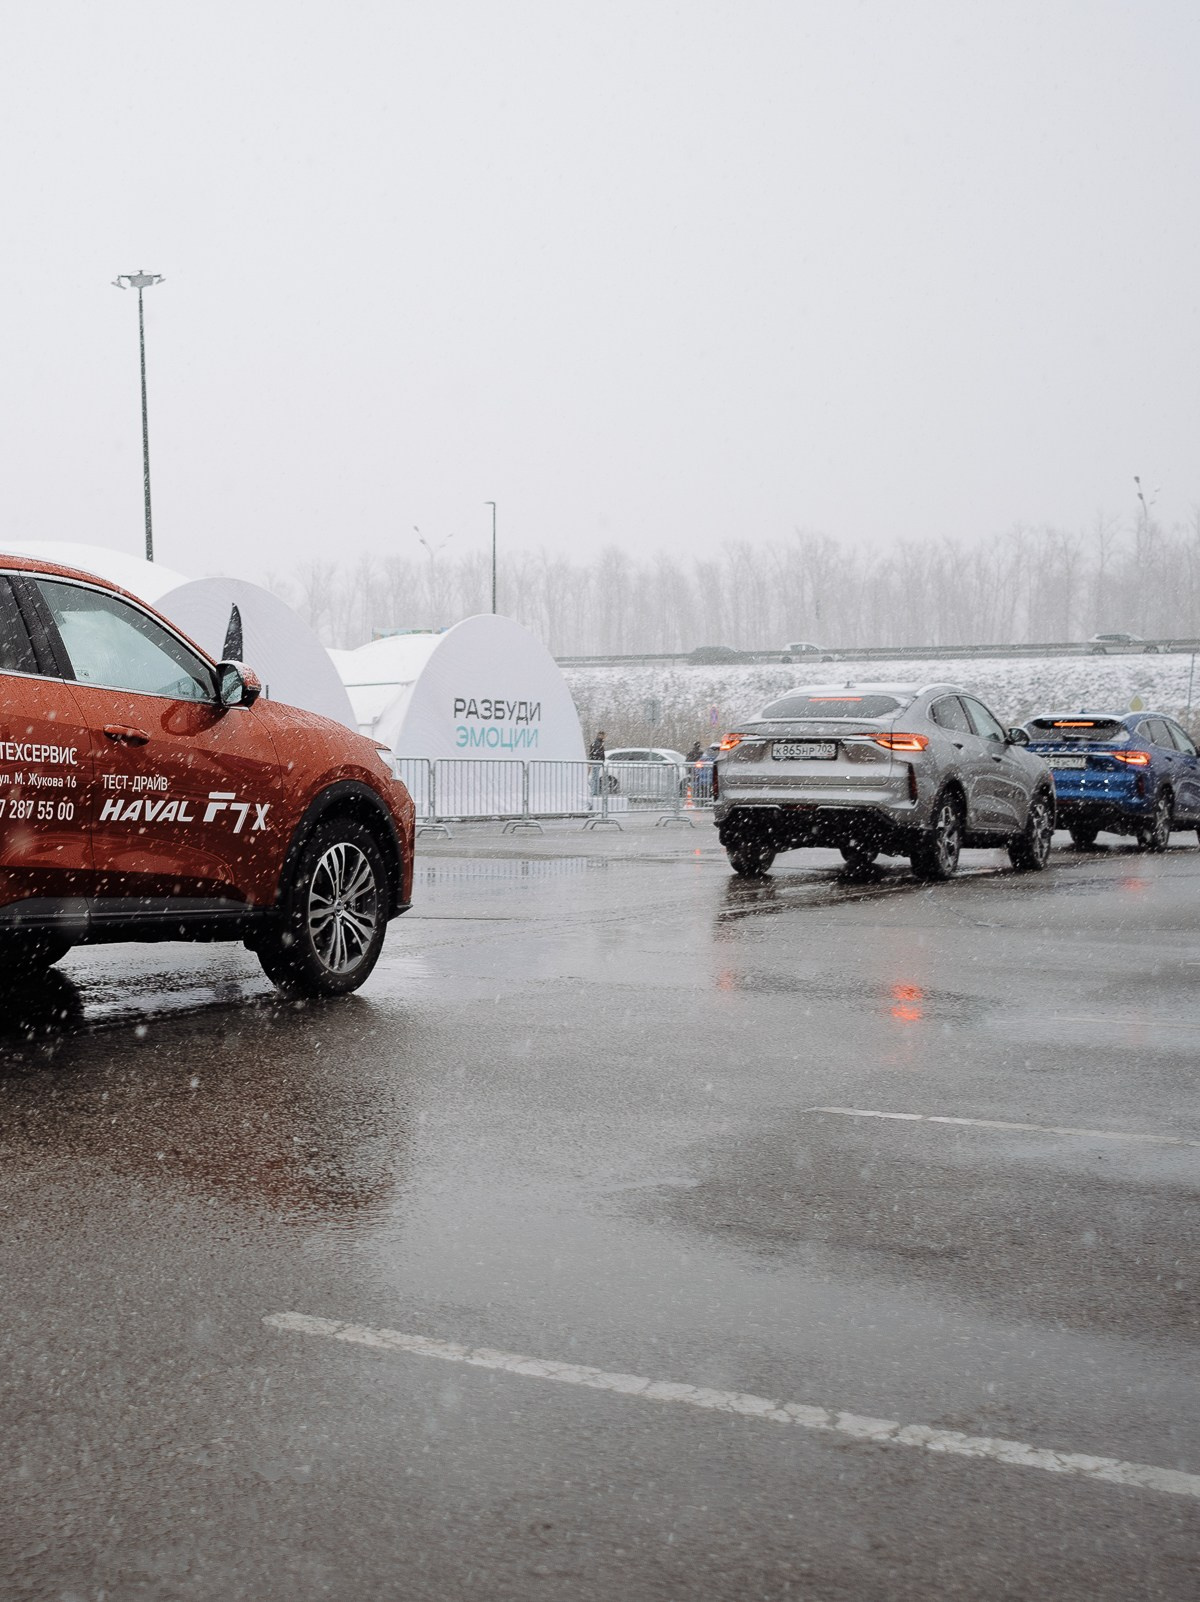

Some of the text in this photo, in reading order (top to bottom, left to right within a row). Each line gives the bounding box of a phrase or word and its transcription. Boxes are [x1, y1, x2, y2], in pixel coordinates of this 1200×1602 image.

[453, 698, 541, 725] РАЗБУДИ
[456, 725, 539, 752] ЭМОЦИИ
[14, 772, 26, 785] М.
[27, 772, 64, 788] Жукова
[66, 775, 77, 788] 16
[102, 774, 168, 792] ТЕСТ-ДРАЙВ
[8, 799, 34, 819] 287
[37, 800, 54, 820] 55
[57, 802, 74, 821] 00
[99, 799, 194, 822] HAVAL
